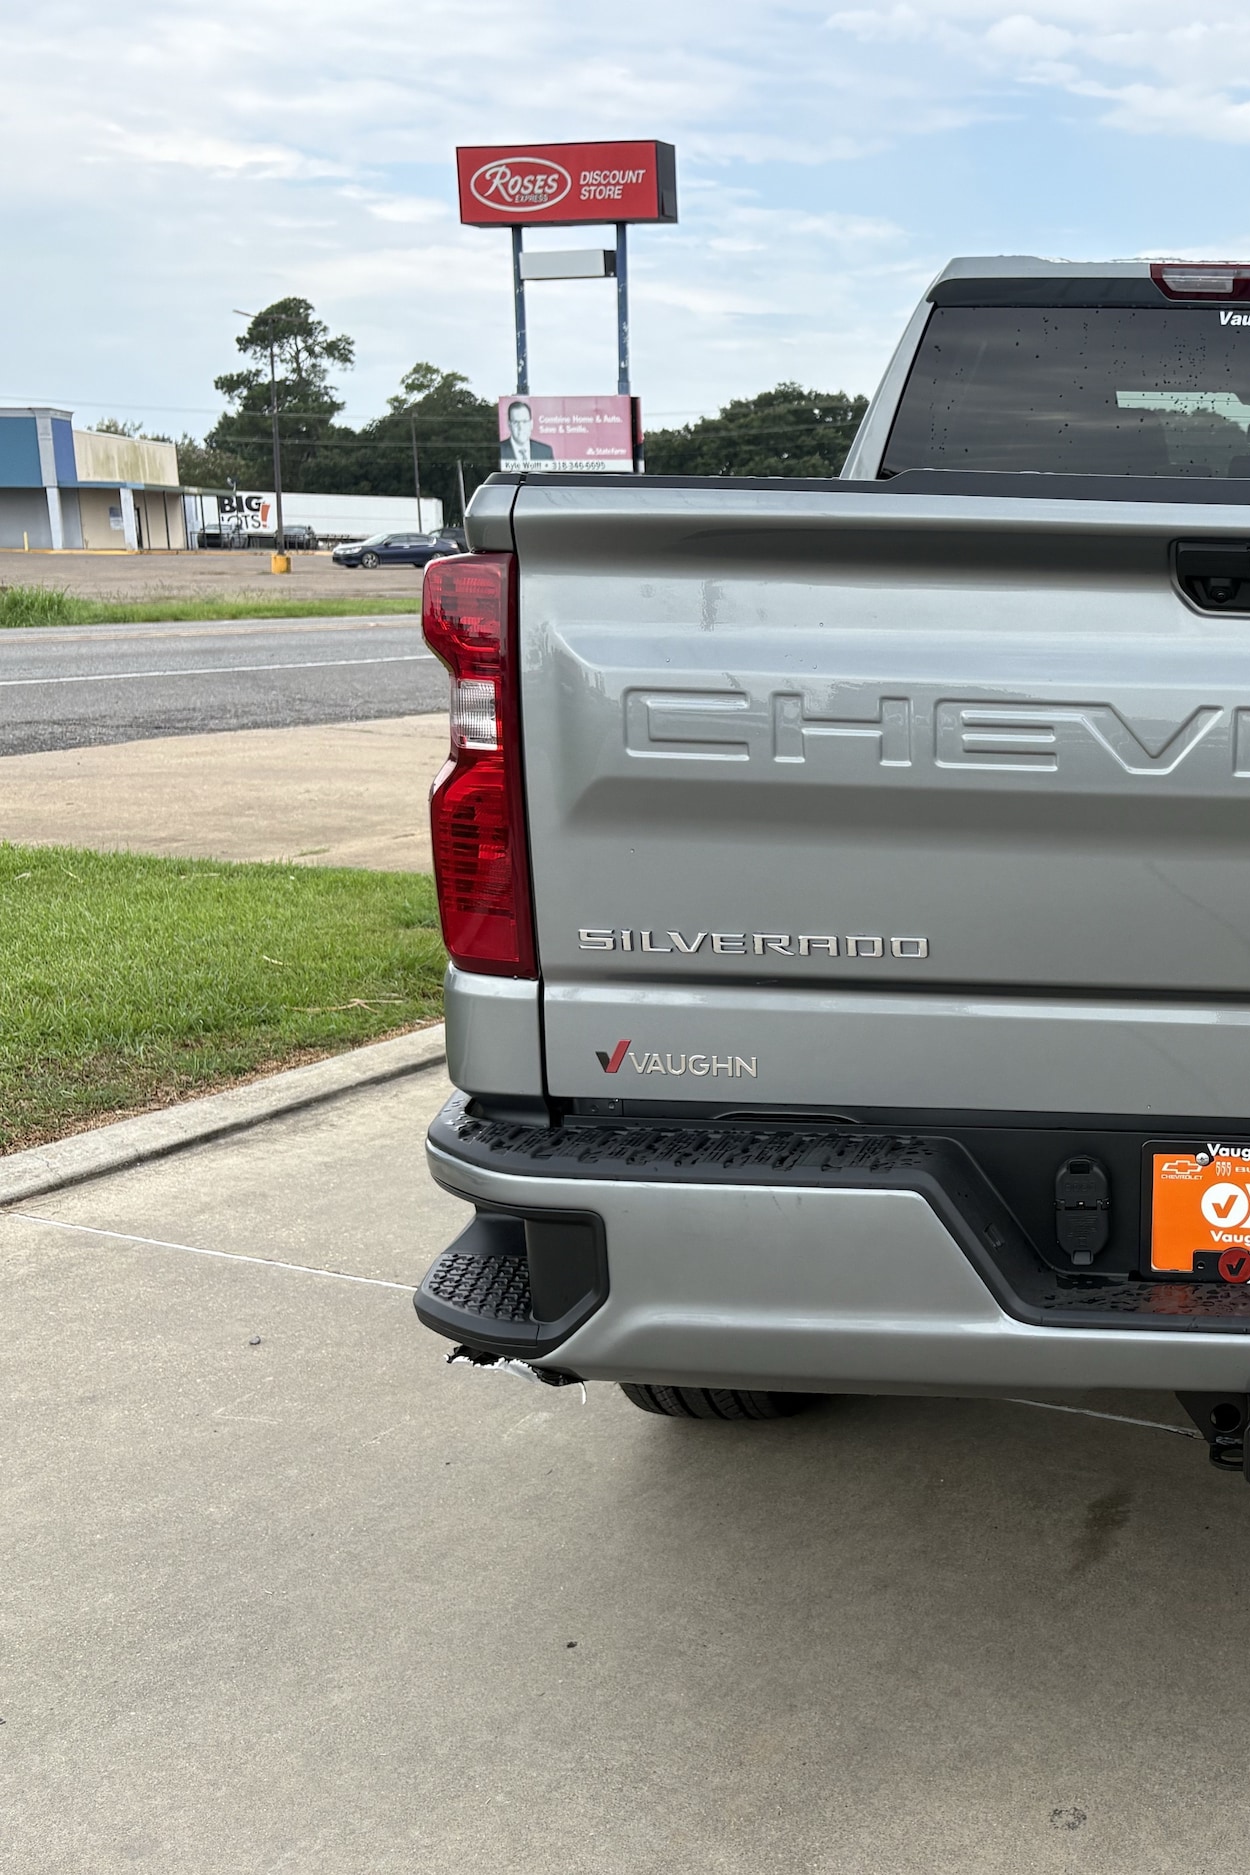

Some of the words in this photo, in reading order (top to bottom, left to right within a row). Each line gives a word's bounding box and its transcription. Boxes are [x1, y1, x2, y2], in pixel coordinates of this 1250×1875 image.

[579, 169, 646, 185] DISCOUNT
[514, 193, 549, 203] EXPRESS
[579, 185, 624, 201] STORE
[538, 415, 571, 424] Combine
[573, 415, 594, 424] Home
[595, 415, 602, 424] &
[603, 414, 623, 424] Auto.
[539, 425, 557, 434] Save
[558, 425, 565, 434] &
[566, 424, 590, 434] Smile.
[219, 495, 264, 514] BIG
[577, 928, 930, 960] SILVERADO
[627, 1051, 759, 1079] VAUGHN
